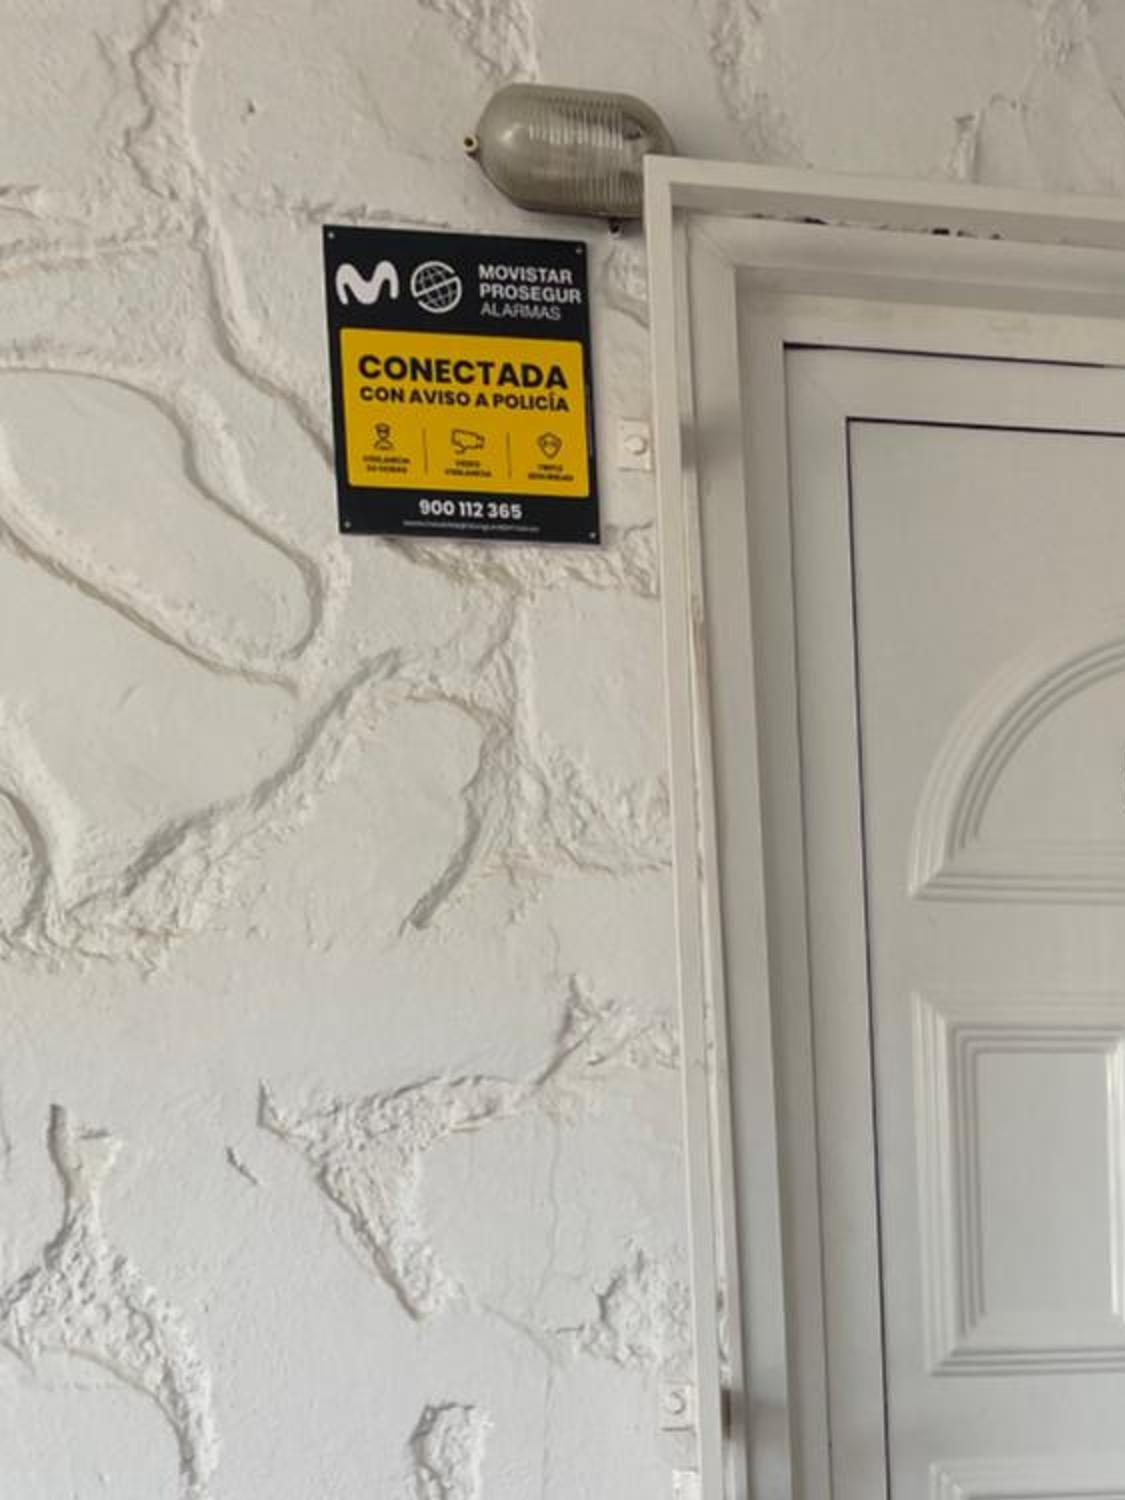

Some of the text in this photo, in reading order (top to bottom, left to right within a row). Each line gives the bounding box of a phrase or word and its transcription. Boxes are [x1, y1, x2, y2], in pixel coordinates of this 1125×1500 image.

[479, 264, 573, 285] MOVISTAR
[479, 284, 582, 304] PROSEGUR
[480, 302, 562, 321] ALARMAS
[358, 355, 568, 389] CONECTADA
[360, 386, 570, 412] CON AVISO A POLICÍA
[419, 499, 523, 520] 900 112 365
